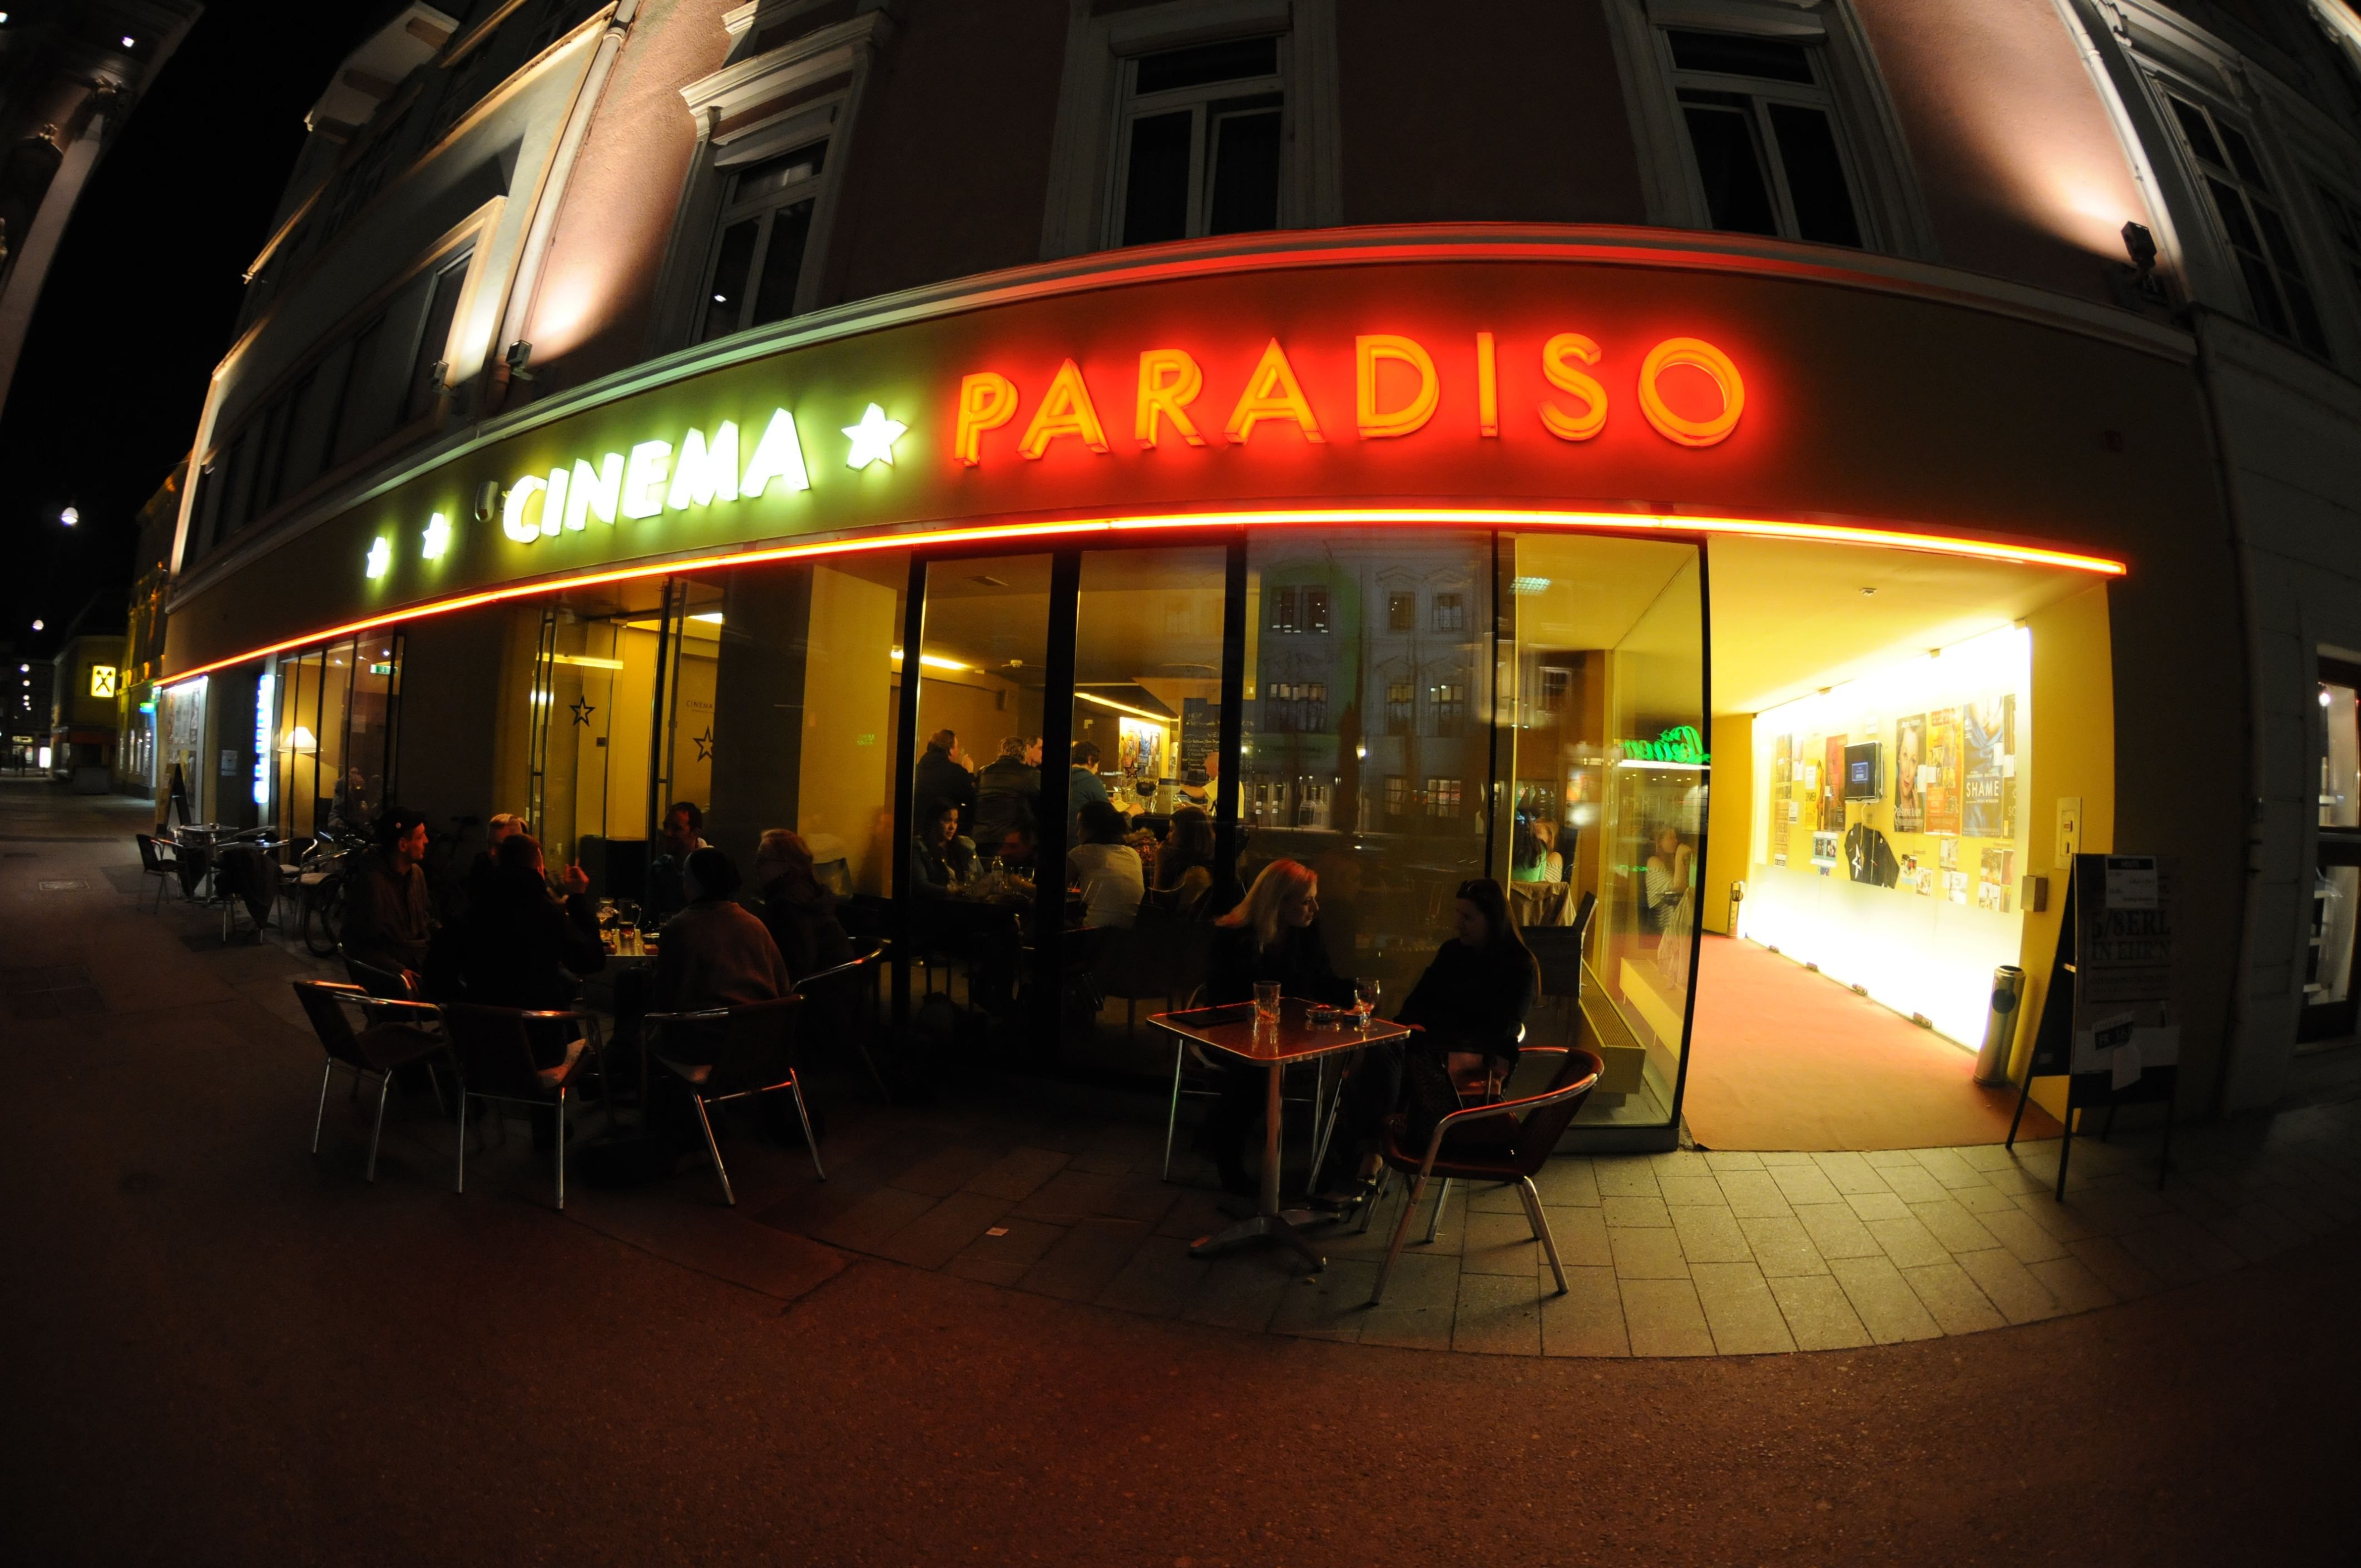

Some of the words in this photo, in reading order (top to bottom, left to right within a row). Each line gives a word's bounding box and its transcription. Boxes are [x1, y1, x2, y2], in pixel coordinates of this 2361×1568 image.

[503, 408, 810, 543] CINEMA
[954, 333, 1745, 467] PARADISO
[1966, 780, 1999, 797] SHAME
[2091, 909, 2172, 940] 5/8ERL
[2091, 940, 2112, 961] IN
